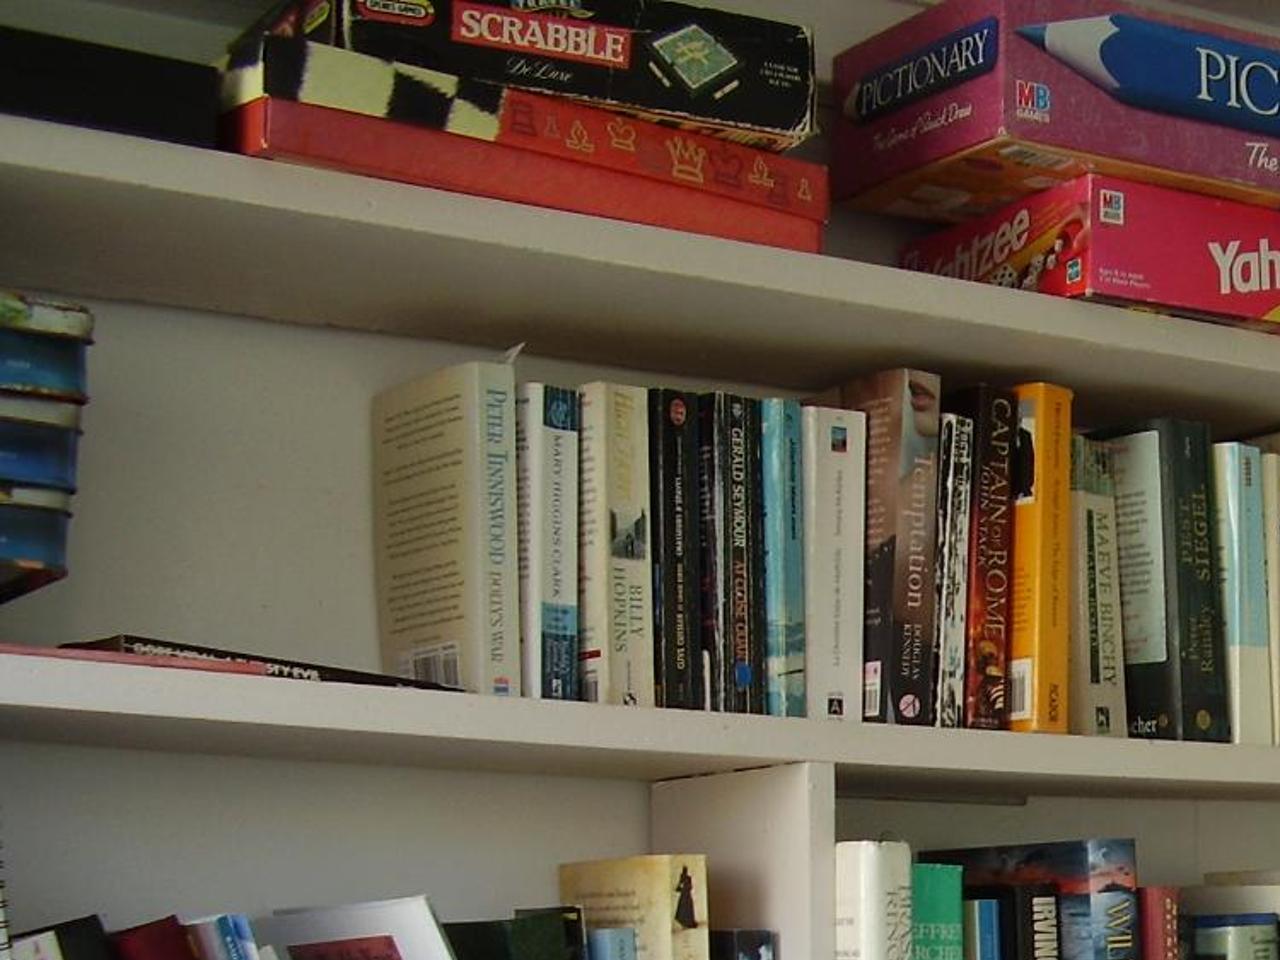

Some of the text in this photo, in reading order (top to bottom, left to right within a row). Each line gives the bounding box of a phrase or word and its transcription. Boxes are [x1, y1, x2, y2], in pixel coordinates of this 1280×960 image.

[459, 10, 627, 62] SCRABBLE
[860, 29, 988, 114] PICTIONARY
[1016, 80, 1050, 111] MB
[1246, 142, 1279, 171] The
[484, 388, 509, 443] PETER
[729, 428, 744, 480] GERALD
[989, 398, 1012, 526] CAPTAIN
[484, 452, 512, 565] TINNISWOOD
[549, 434, 563, 598] MARY HIGGINS CLARK
[730, 484, 746, 546] SEYMOUR
[895, 451, 935, 609] Temptation
[976, 464, 992, 567] JOHN STACK
[732, 560, 747, 574] AT
[983, 549, 1010, 641] ROME
[611, 566, 631, 652] HOPKINS
[627, 584, 645, 637] BILLY
[732, 577, 748, 618] CLOSE
[1093, 512, 1117, 687] MAEVE BINCHY
[489, 630, 504, 663] WAR
[900, 623, 911, 680] KENNEDY
[912, 622, 922, 683] DOUGLAS
[1131, 712, 1159, 735] cher
